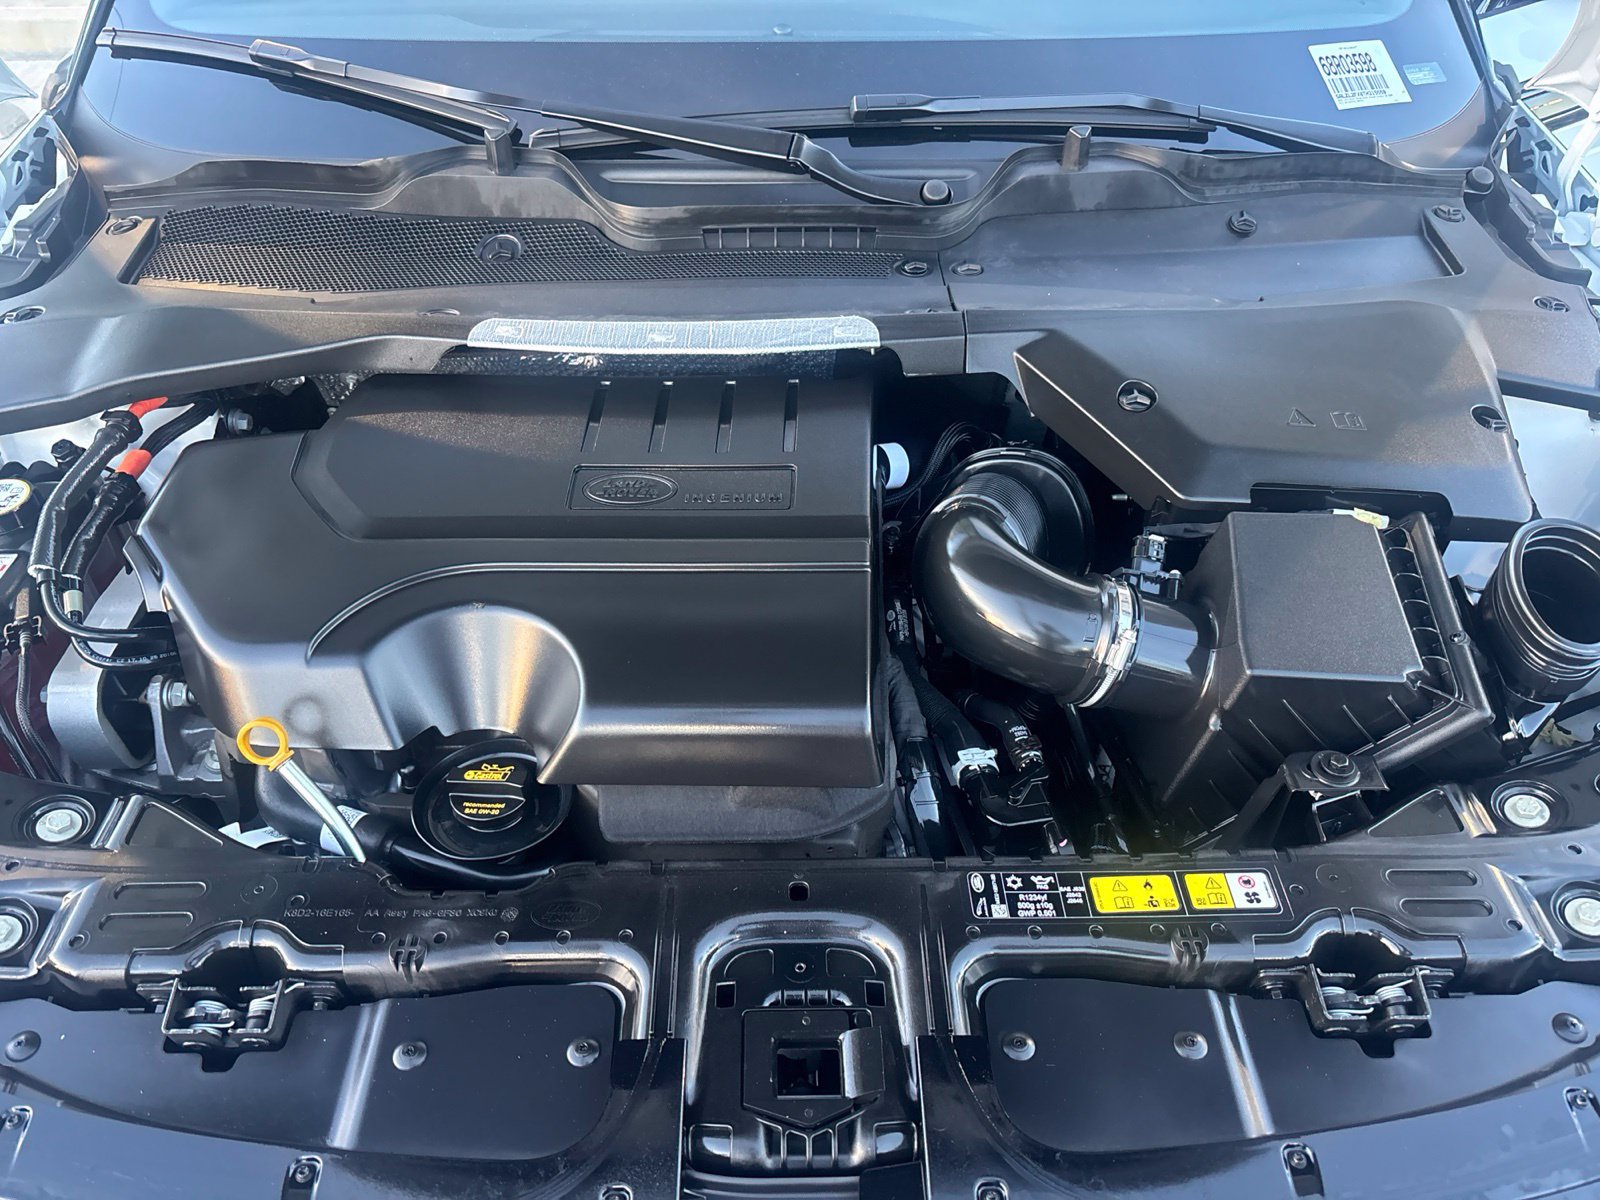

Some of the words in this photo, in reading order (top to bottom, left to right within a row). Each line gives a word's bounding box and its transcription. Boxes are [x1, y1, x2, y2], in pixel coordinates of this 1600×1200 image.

[1318, 52, 1377, 76] 68R03598
[684, 493, 783, 503] INGENIUM
[1017, 902, 1036, 910] 500g
[1017, 909, 1036, 917] GWP
[1037, 909, 1056, 917] 0.501
